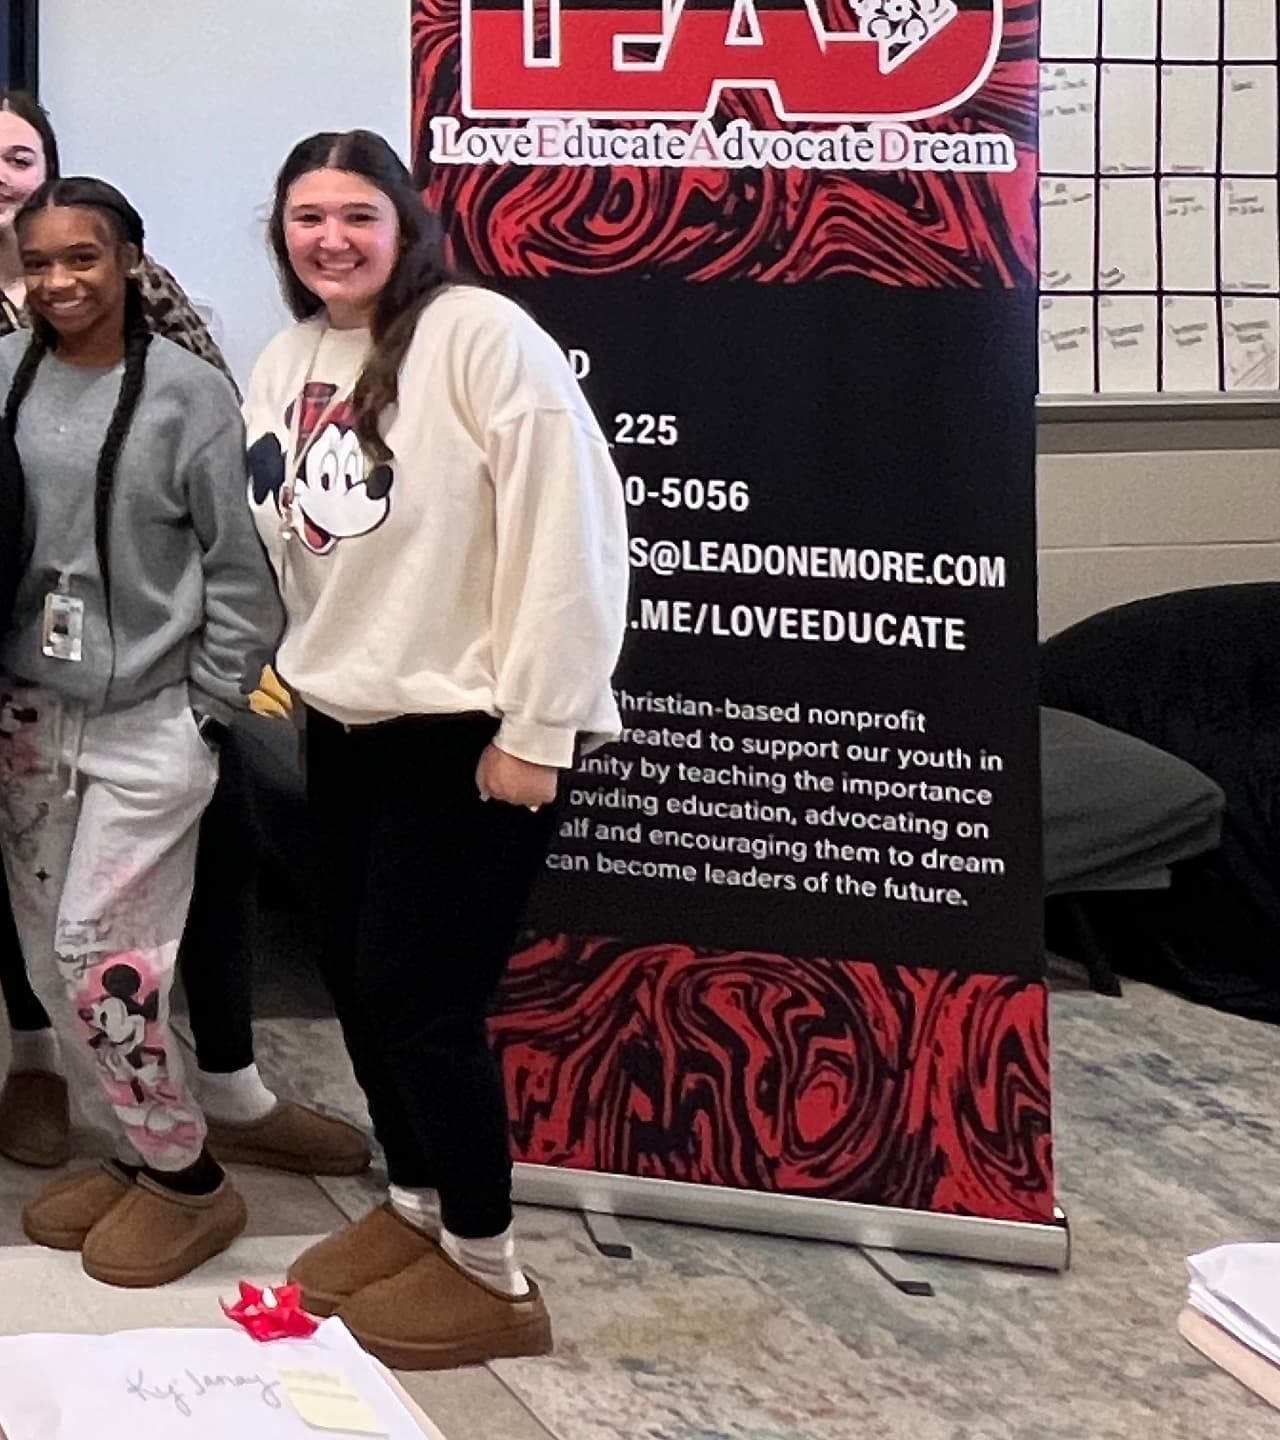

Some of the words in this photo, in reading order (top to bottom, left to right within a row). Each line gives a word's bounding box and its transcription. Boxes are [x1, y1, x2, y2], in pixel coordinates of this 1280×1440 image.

[608, 413, 678, 447] 225
[625, 476, 750, 512] 0-5056
[629, 537, 1007, 588] S@LEADONEMORE.COM
[808, 707, 927, 733] nonprofit
[709, 729, 735, 752] to
[742, 736, 839, 763] support
[846, 742, 891, 763] our
[897, 746, 972, 771] youth
[980, 749, 1004, 772] in
[640, 757, 671, 784] by
[678, 761, 787, 793] teaching
[794, 770, 835, 793] the
[842, 773, 993, 807] importance
[666, 796, 797, 826] education,
[805, 807, 948, 841] advocating
[956, 820, 989, 840] on
[595, 822, 642, 844] and
[648, 828, 808, 862] encouraging
[814, 839, 881, 864] them
[888, 846, 914, 868] to
[921, 850, 1005, 876] dream
[545, 853, 589, 872] can
[597, 854, 698, 882] become
[704, 863, 797, 891] leaders
[803, 871, 829, 893] of
[836, 875, 877, 898] the
[884, 878, 969, 907] future.
